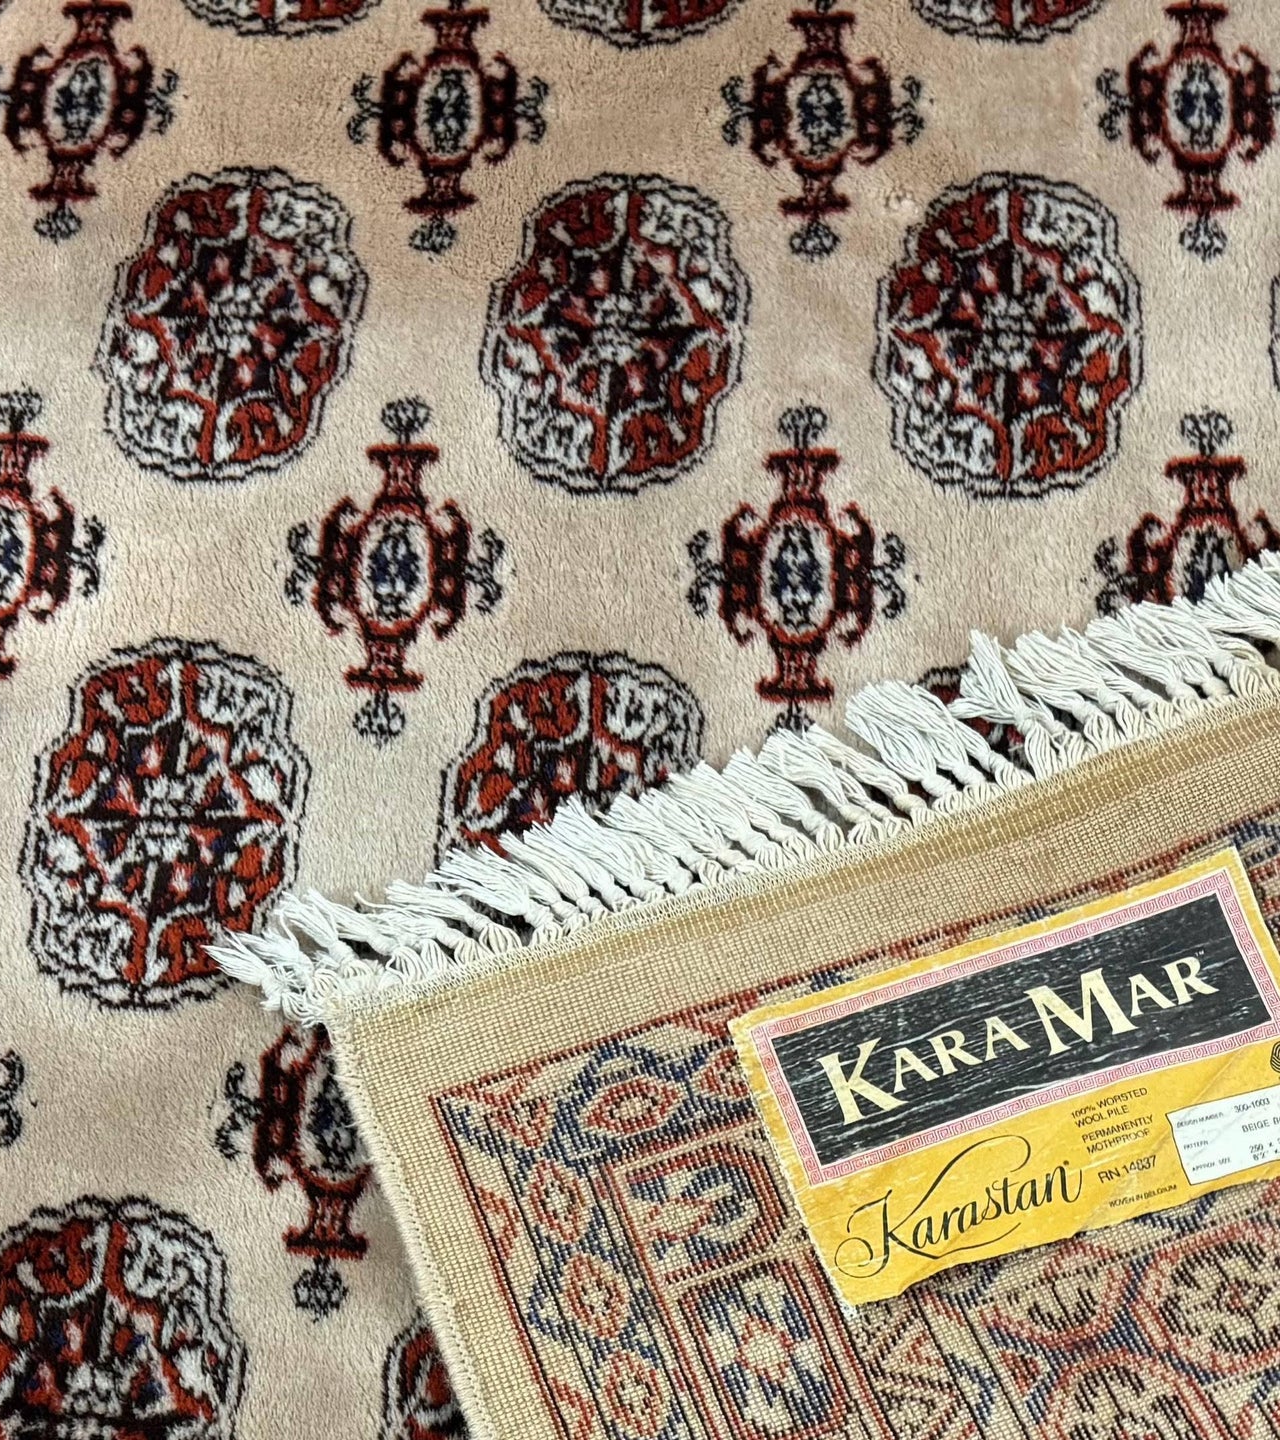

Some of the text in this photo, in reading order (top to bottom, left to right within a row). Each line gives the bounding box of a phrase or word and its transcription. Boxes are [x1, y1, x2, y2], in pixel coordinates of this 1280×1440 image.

[816, 1015, 1030, 1126] KARA
[1071, 1087, 1148, 1119] 100% WORSTED
[1075, 1105, 1129, 1128] WOOL PILE
[1081, 1114, 1153, 1143] PERMANENTLY
[1241, 1120, 1270, 1133] BEIGE
[1086, 1128, 1150, 1154] MOTHPROOF
[1097, 1166, 1121, 1184] RN
[834, 1134, 1083, 1279] Karastan
[1109, 1196, 1135, 1208] WOVEN
[1144, 1184, 1178, 1200] BELGIUM
